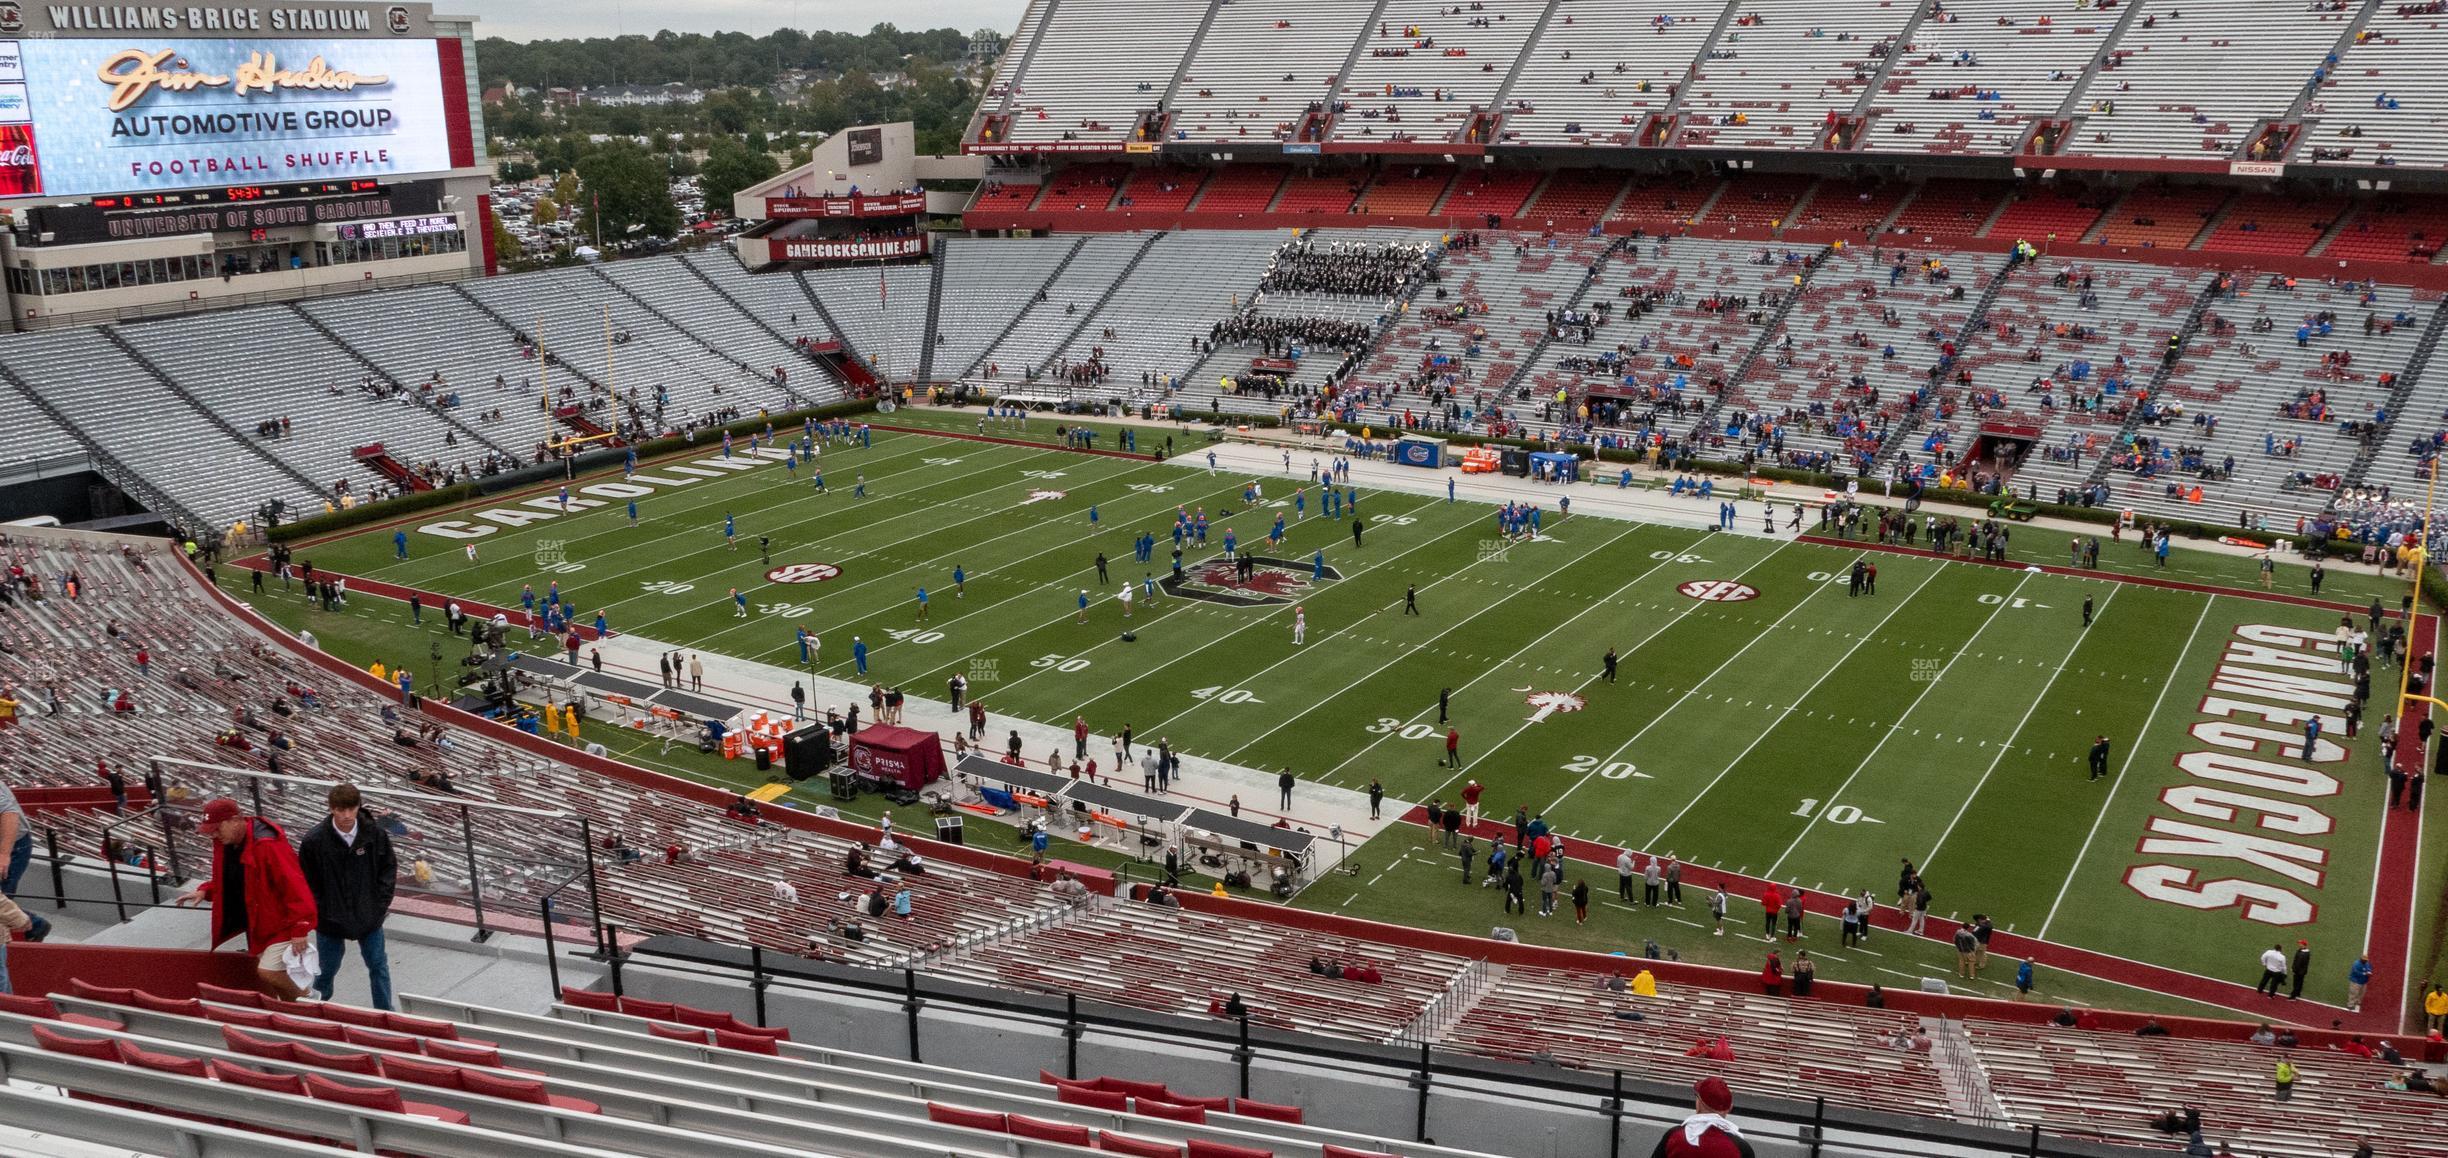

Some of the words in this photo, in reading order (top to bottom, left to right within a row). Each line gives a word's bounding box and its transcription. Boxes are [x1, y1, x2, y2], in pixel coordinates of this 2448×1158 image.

[49, 5, 260, 31] WILLIAMS-BRICE
[272, 8, 370, 31] STADIUM
[97, 48, 230, 113] Jim
[235, 50, 389, 97] Hudson
[111, 112, 298, 138] AUTOMOTIVE
[305, 108, 393, 130] GROUP
[132, 155, 269, 178] FOOTBALL
[285, 149, 390, 167] SHUFFLE
[2237, 166, 2276, 174] NISSAN
[227, 185, 261, 201] 54:34
[109, 213, 218, 237] UNIVERSITY
[227, 210, 248, 227] OF
[254, 205, 307, 225] SOUTH
[315, 199, 393, 220] CAROLINA
[400, 219, 417, 228] FEED
[251, 229, 267, 241] 25
[786, 239, 922, 258] GAMECOCKSONLINE.COM
[415, 447, 806, 540] CAROLINA
[1650, 550, 1701, 564] 30
[538, 562, 587, 574] 10
[768, 563, 839, 583] SEC
[640, 580, 695, 595] 20
[1679, 580, 1757, 601] SEC
[758, 602, 814, 619] 30
[1977, 594, 2032, 609] 10
[888, 628, 946, 644] 40
[1030, 653, 1092, 673] 50
[1190, 686, 1254, 704] 40
[1365, 717, 1435, 740] 30
[875, 756, 905, 769] PRISMA
[1560, 755, 1638, 780] 20
[2120, 623, 2371, 928] GAMECOCKS
[1790, 798, 1864, 826] 10
